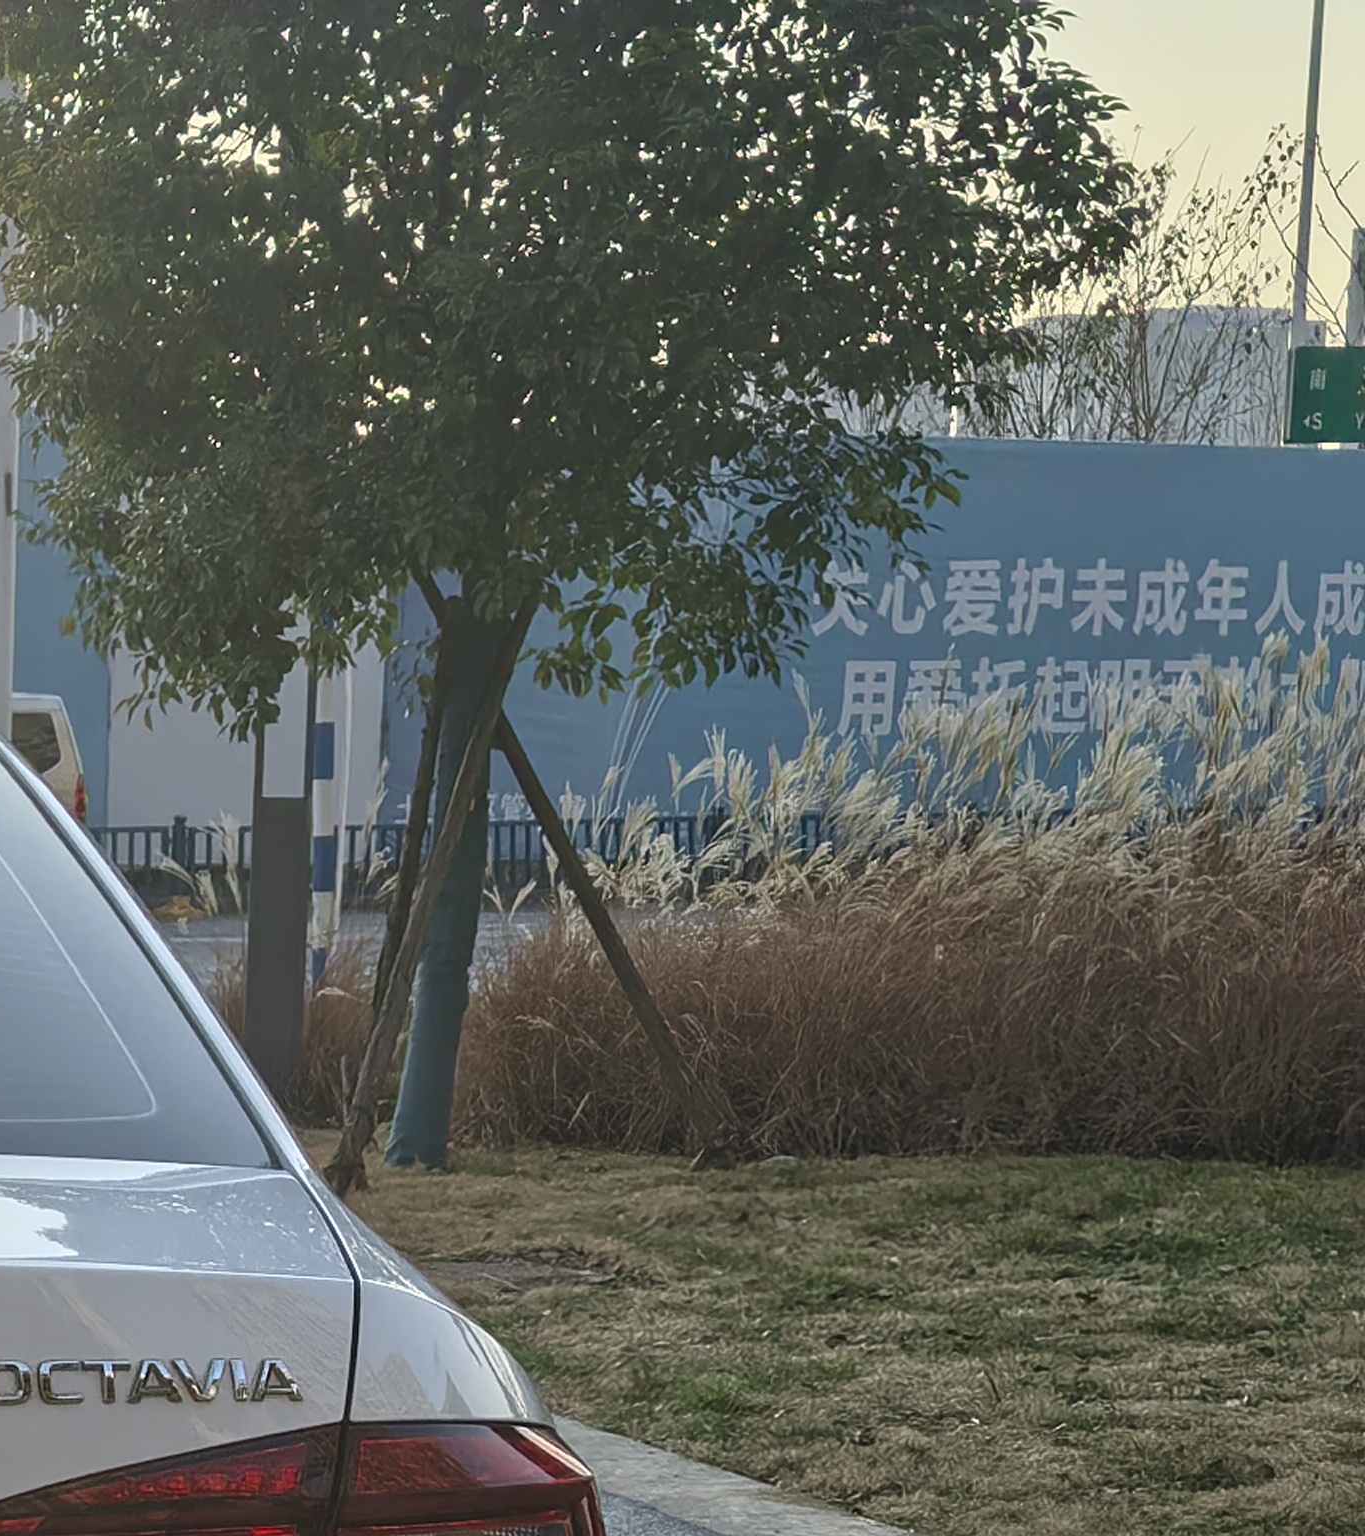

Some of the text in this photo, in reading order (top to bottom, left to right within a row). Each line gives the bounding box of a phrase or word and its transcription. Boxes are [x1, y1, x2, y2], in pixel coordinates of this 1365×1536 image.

[1311, 411, 1323, 430] S
[810, 557, 1365, 637] 关心爱护未成年人成
